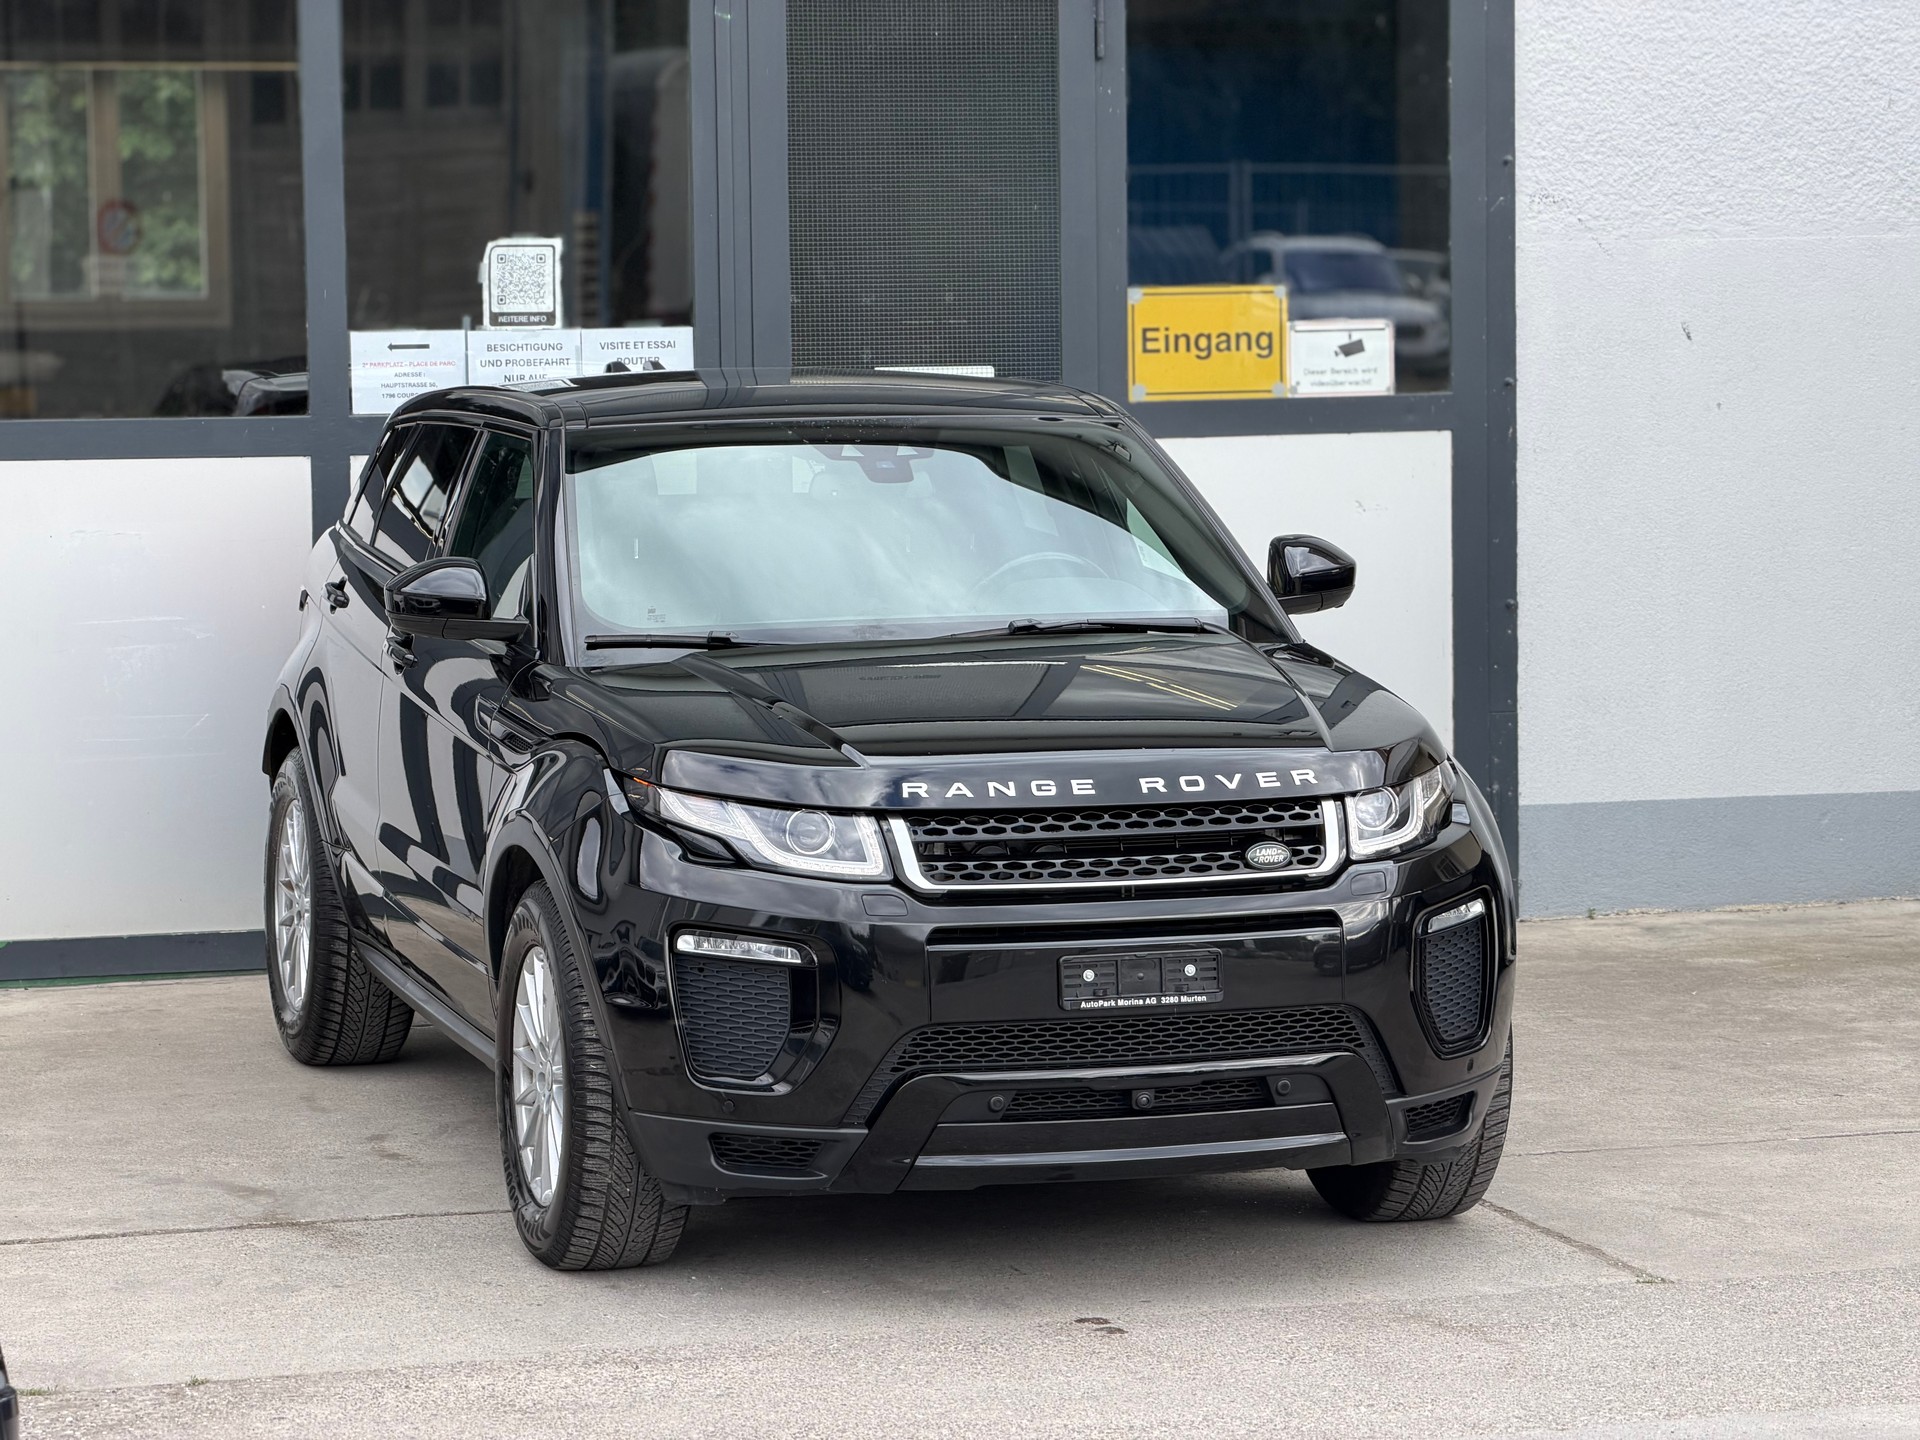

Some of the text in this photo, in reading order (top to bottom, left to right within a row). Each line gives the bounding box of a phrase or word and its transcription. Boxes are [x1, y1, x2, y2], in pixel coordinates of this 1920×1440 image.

[486, 342, 563, 352] BESICHTIGUNG
[599, 340, 676, 350] VISITE ET ESSAI
[1141, 326, 1274, 361] Eingang
[480, 358, 571, 368] UND PROBEFAHRT
[504, 373, 526, 383] NUR
[901, 768, 1319, 798] RANGE ROVER
[1256, 848, 1277, 856] LAND
[1258, 855, 1284, 863] ROVER
[1080, 1000, 1116, 1009] AutoPark
